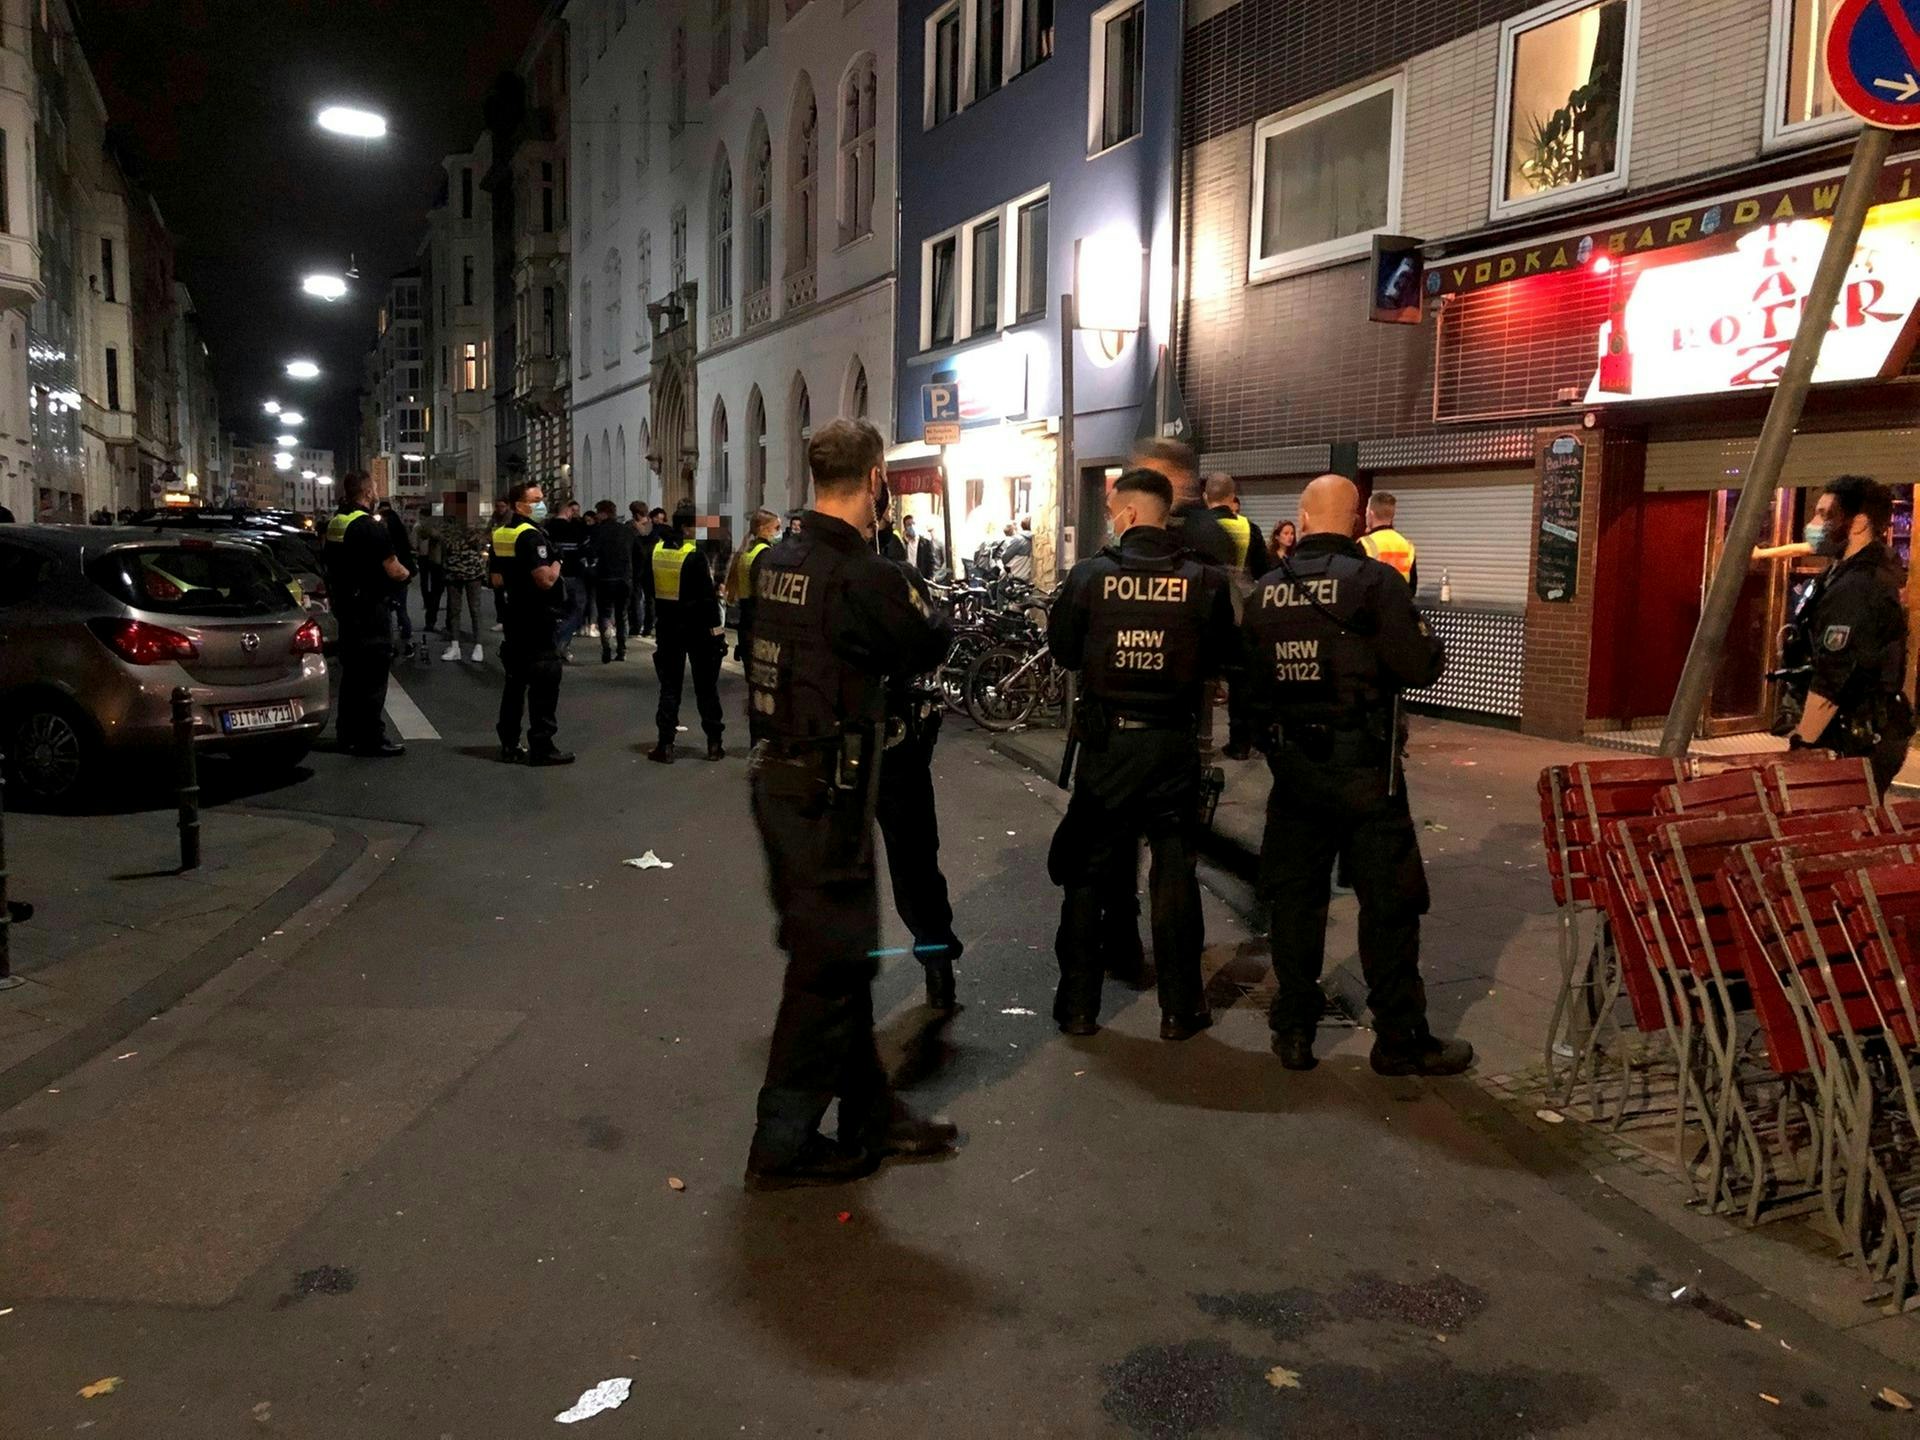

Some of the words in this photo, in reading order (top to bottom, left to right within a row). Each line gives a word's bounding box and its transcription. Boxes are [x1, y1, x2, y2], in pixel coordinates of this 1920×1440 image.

[1452, 246, 1568, 287] VODKA
[1608, 216, 1692, 252] BAR
[1733, 168, 1910, 225] DAWi
[930, 388, 950, 418] P
[1103, 576, 1189, 603] POLIZEI
[1117, 630, 1165, 648] NRW
[1275, 640, 1319, 660] NRW
[1115, 651, 1164, 670] 31123
[1276, 662, 1321, 681] 31122
[230, 711, 251, 727] BIT
[257, 708, 272, 724] MK
[272, 706, 291, 722] 711
